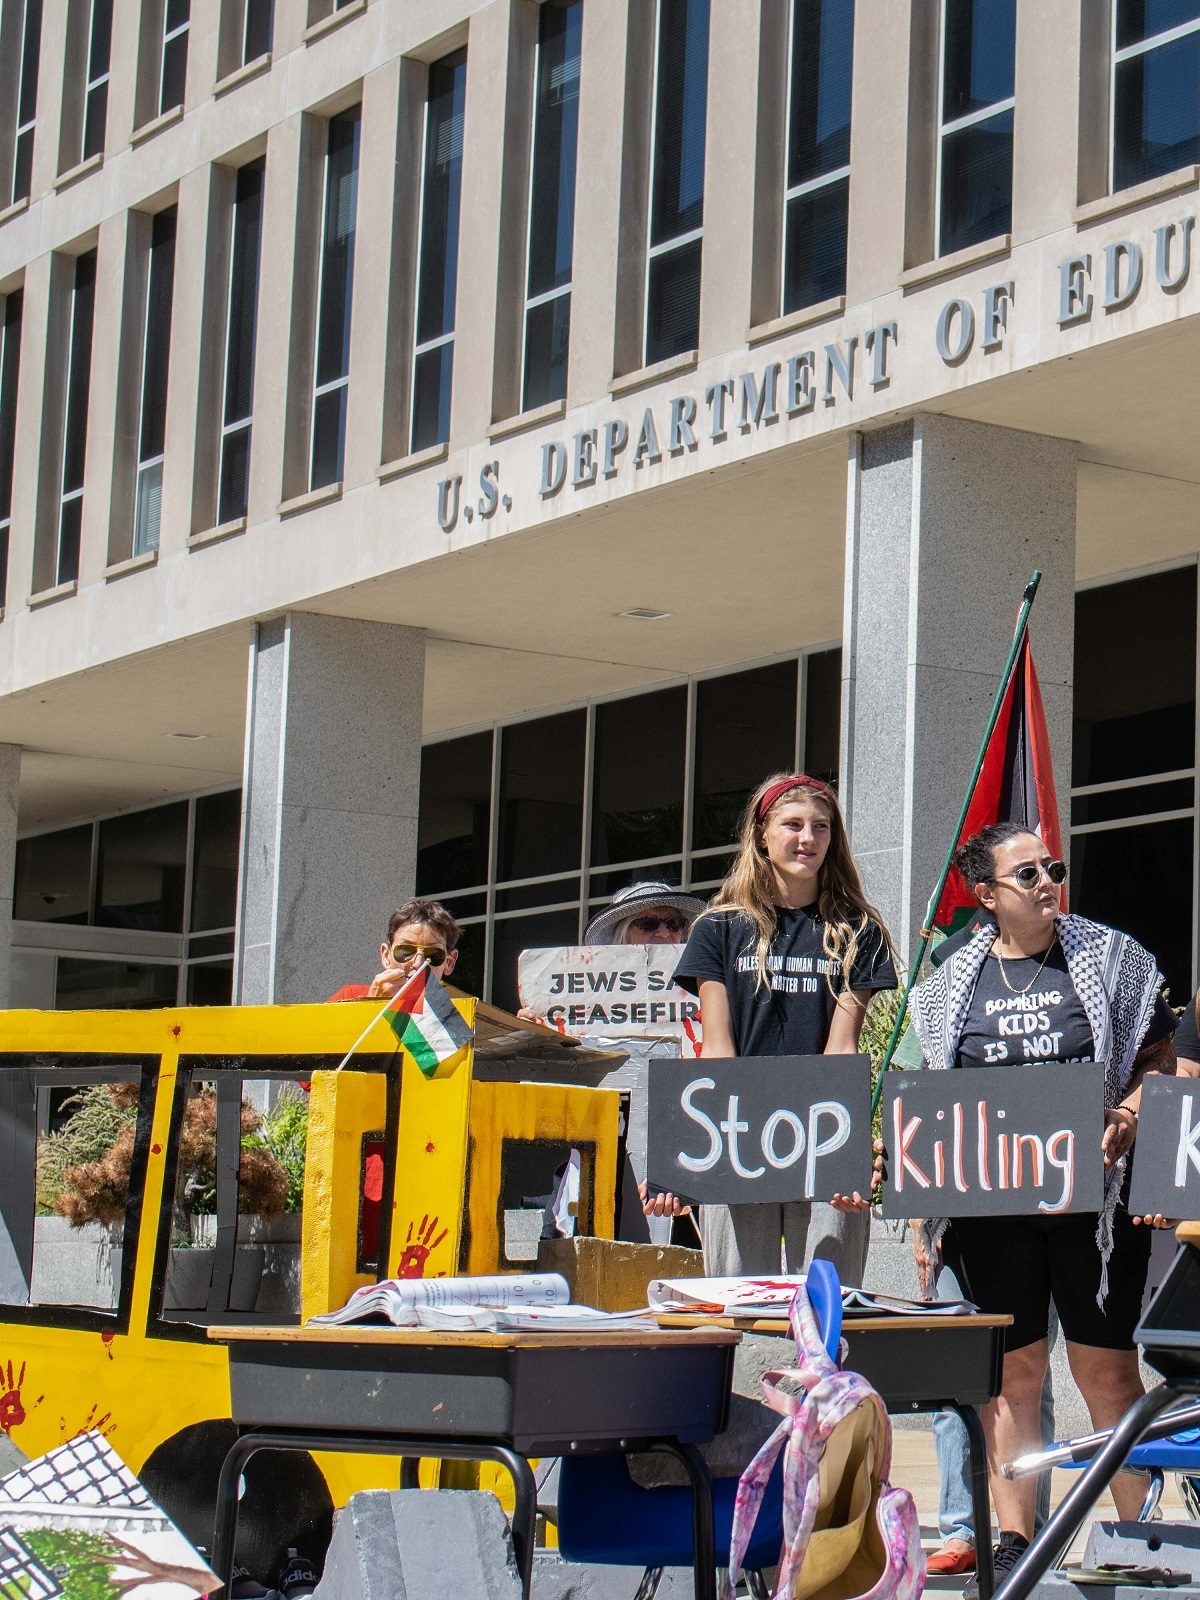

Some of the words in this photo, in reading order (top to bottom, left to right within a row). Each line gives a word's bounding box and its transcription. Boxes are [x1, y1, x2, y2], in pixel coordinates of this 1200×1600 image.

[437, 461, 512, 532] U.S.
[540, 322, 898, 499] DEPARTMENT
[935, 280, 1015, 366] OF
[786, 957, 813, 973] HUMAN
[550, 971, 637, 994] JEWS
[771, 975, 798, 993] MATTER
[803, 977, 818, 993] TOO
[547, 1002, 700, 1027] CEASEFIR
[986, 990, 1063, 1016] BOMBING
[998, 1011, 1050, 1036] KIDS
[983, 1040, 1008, 1062] IS
[1023, 1032, 1063, 1058] NOT
[677, 1077, 851, 1199] Stop
[893, 1097, 1075, 1213] killing
